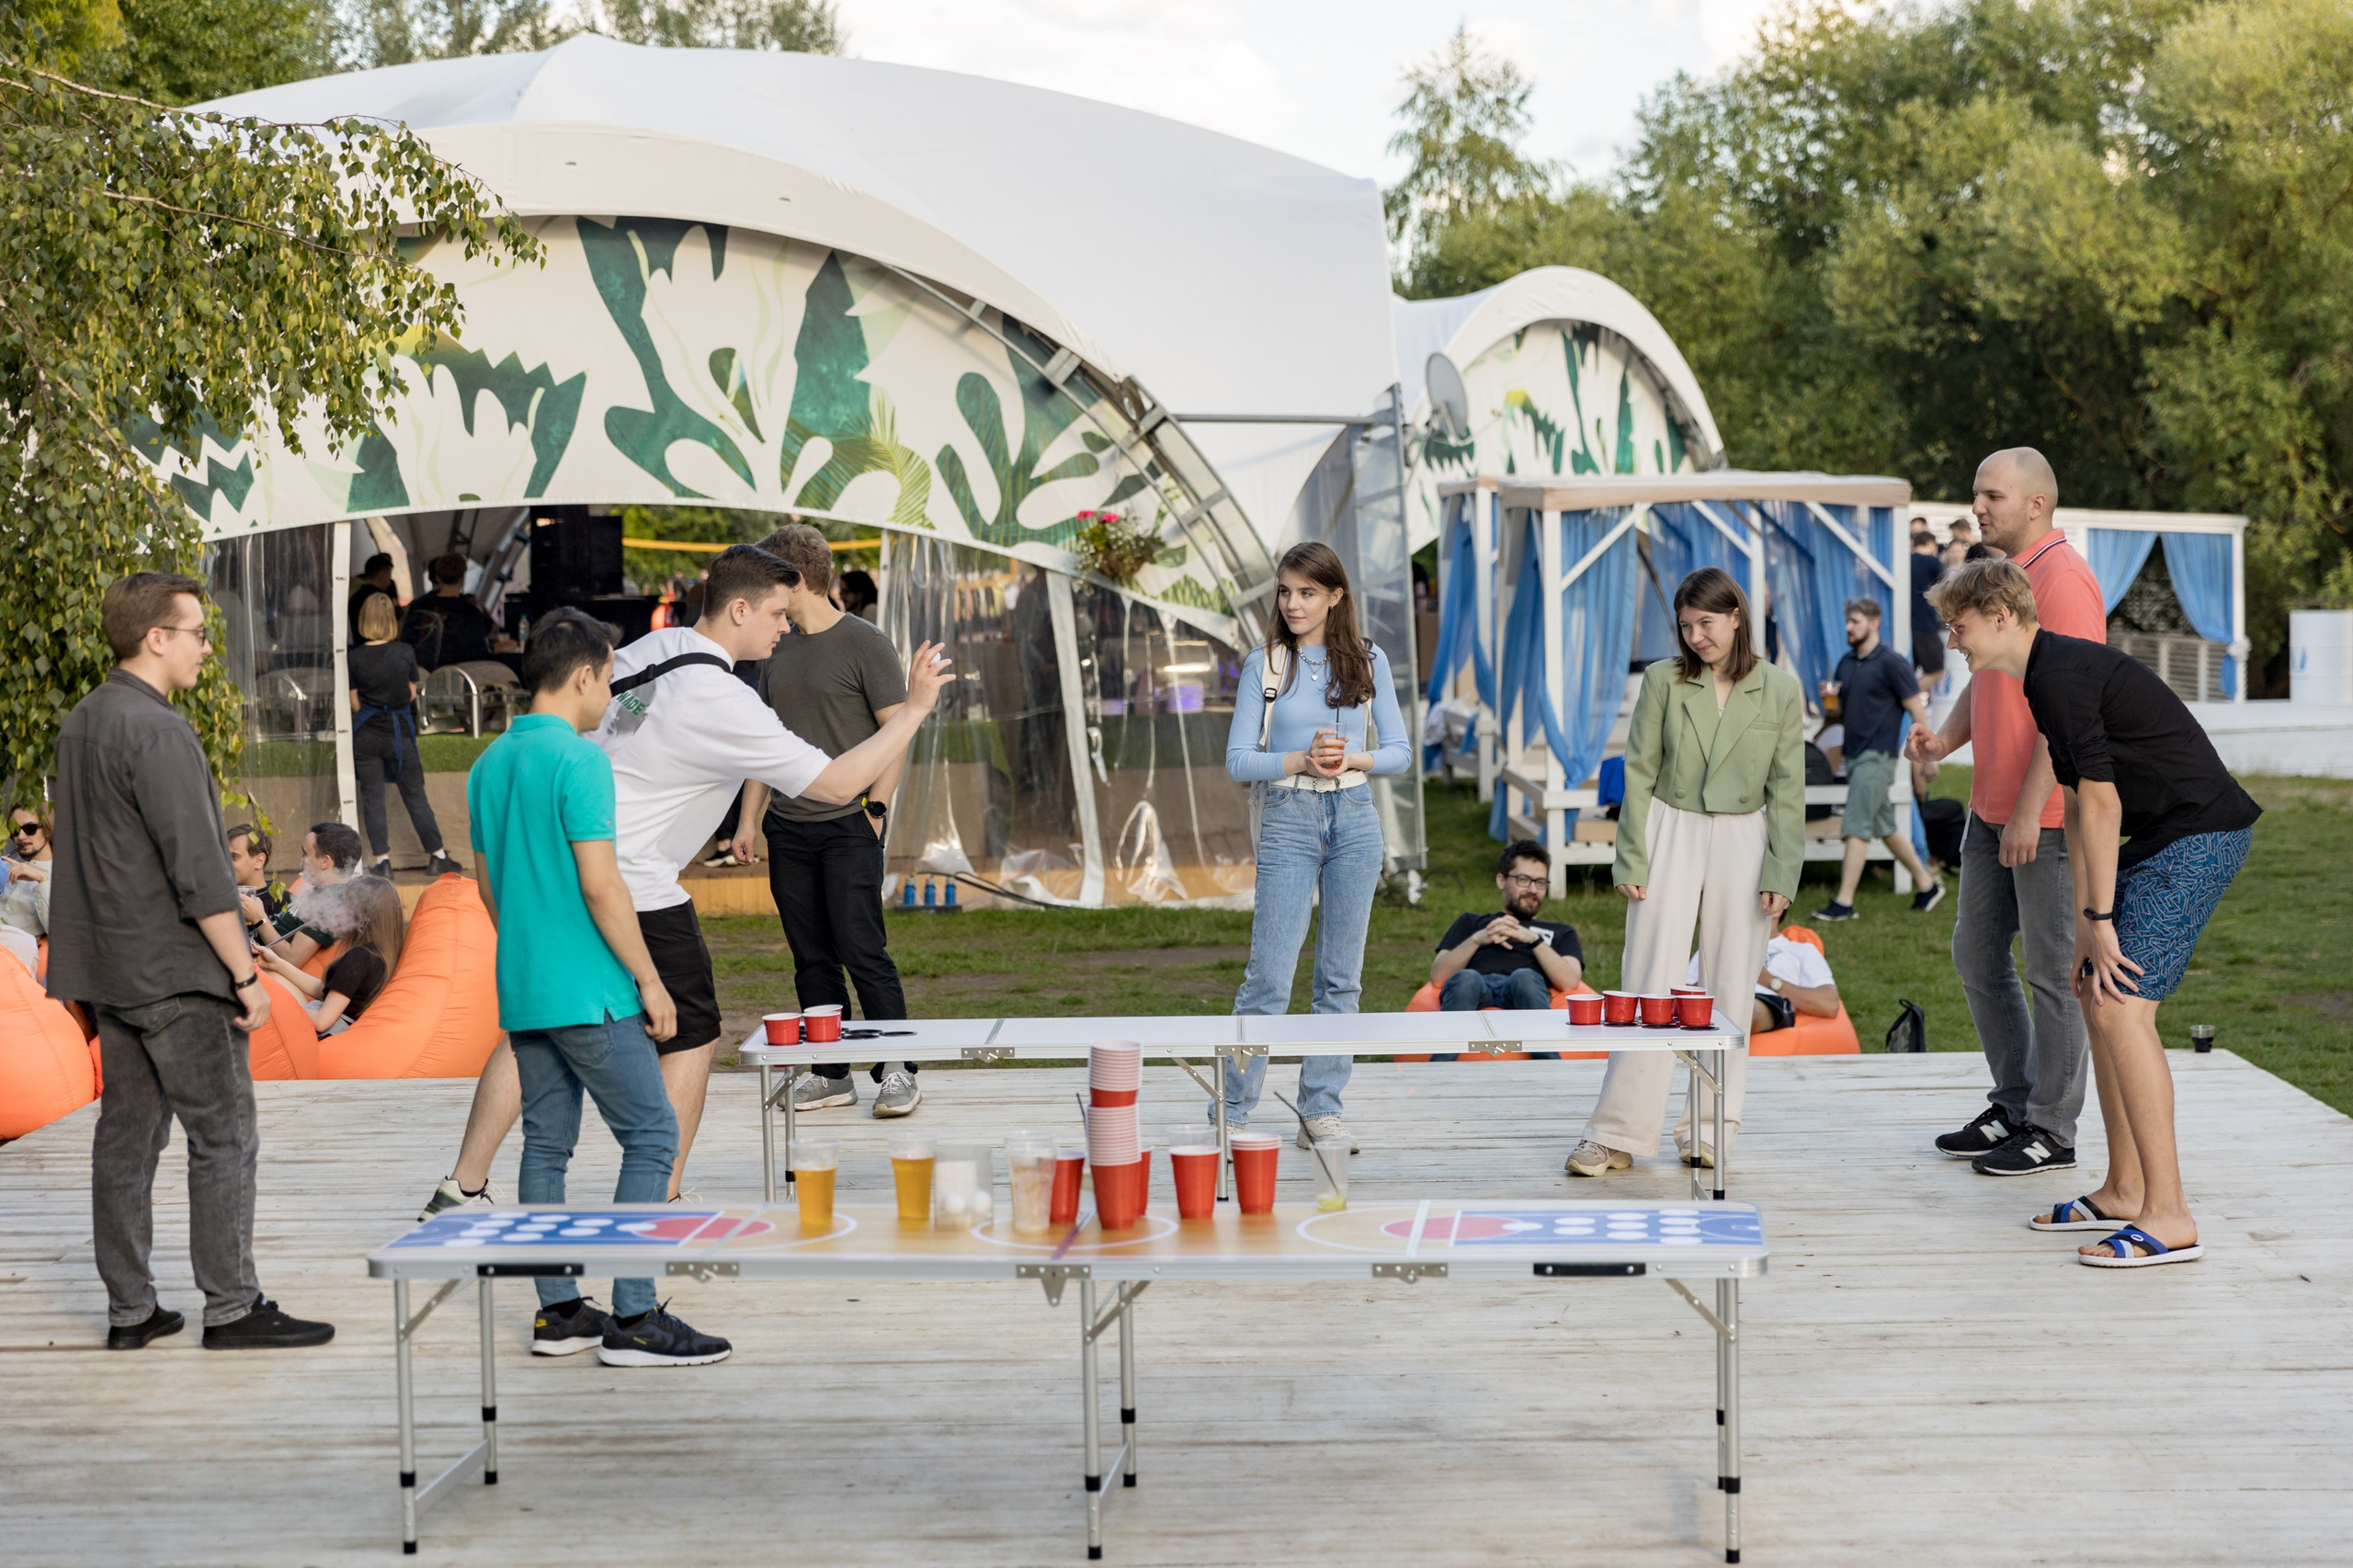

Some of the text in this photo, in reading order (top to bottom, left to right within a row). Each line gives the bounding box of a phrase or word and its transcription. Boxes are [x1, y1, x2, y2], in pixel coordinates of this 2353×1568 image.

[616, 691, 646, 716] WADE
[1979, 1119, 2010, 1142] N
[2022, 1141, 2052, 1165] N
